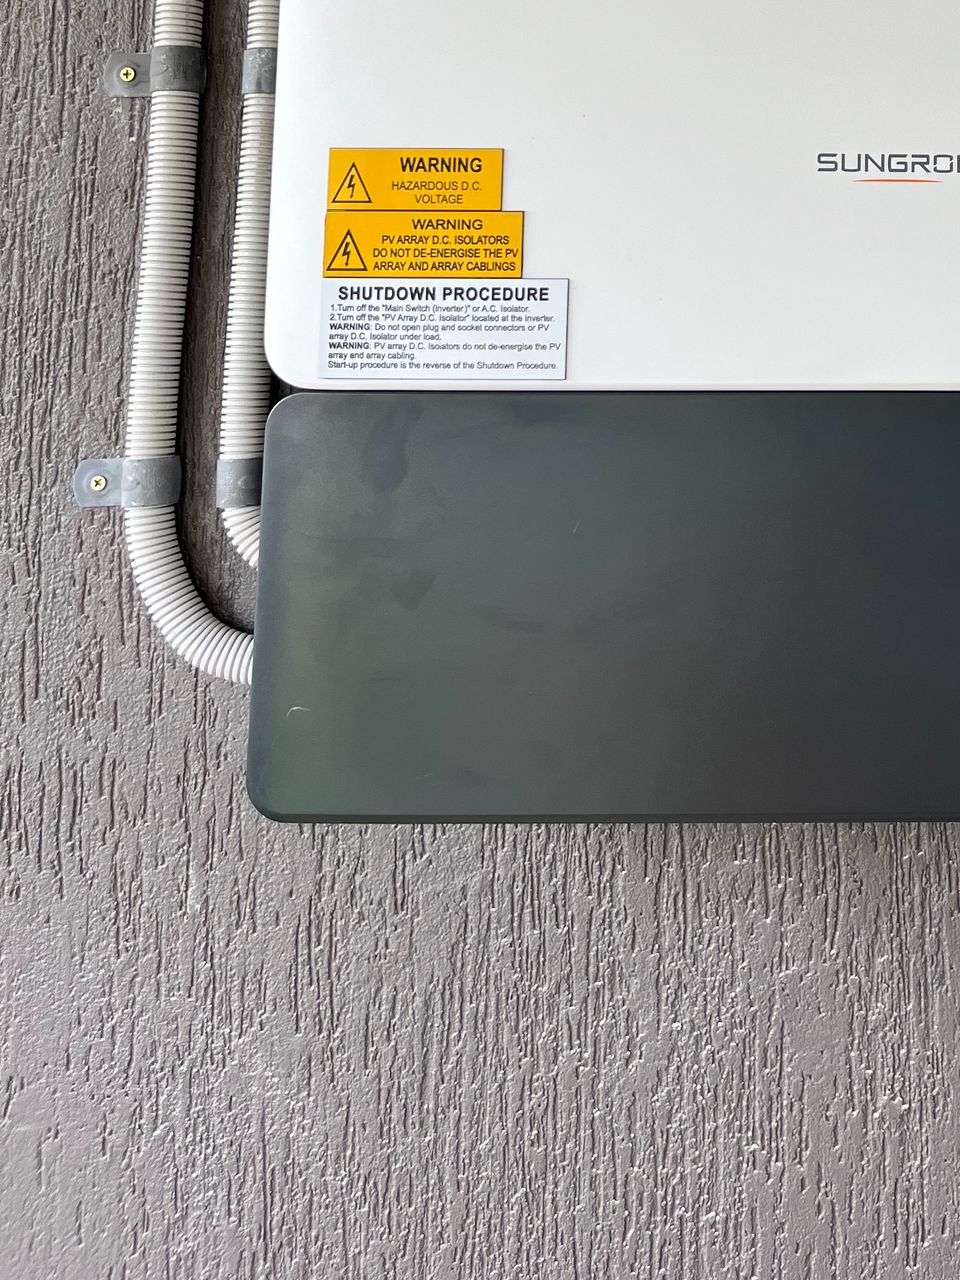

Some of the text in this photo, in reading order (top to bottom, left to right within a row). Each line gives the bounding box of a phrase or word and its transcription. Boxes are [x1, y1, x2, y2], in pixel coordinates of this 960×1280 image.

[400, 157, 482, 173] WARNING
[392, 181, 482, 191] HAZARDOUS D.C.
[415, 194, 464, 204] VOLTAGE
[412, 219, 483, 230] WARNING
[382, 235, 510, 245] PV ARRAY D.C. ISOLATORS
[373, 248, 519, 258] DO NOT DE-ENERGISE THE PV
[373, 262, 516, 271] ARRAY AND ARRAY CABLINGS
[338, 286, 549, 302] SHUTDOWN PROCEDURE
[398, 314, 418, 323] Array
[423, 324, 439, 332] plug
[387, 343, 407, 351] array
[409, 342, 425, 350] D.C.
[488, 343, 533, 352] de-energise
[387, 352, 416, 360] cabling.
[328, 361, 358, 369] Start-up
[360, 361, 398, 370] procedure
